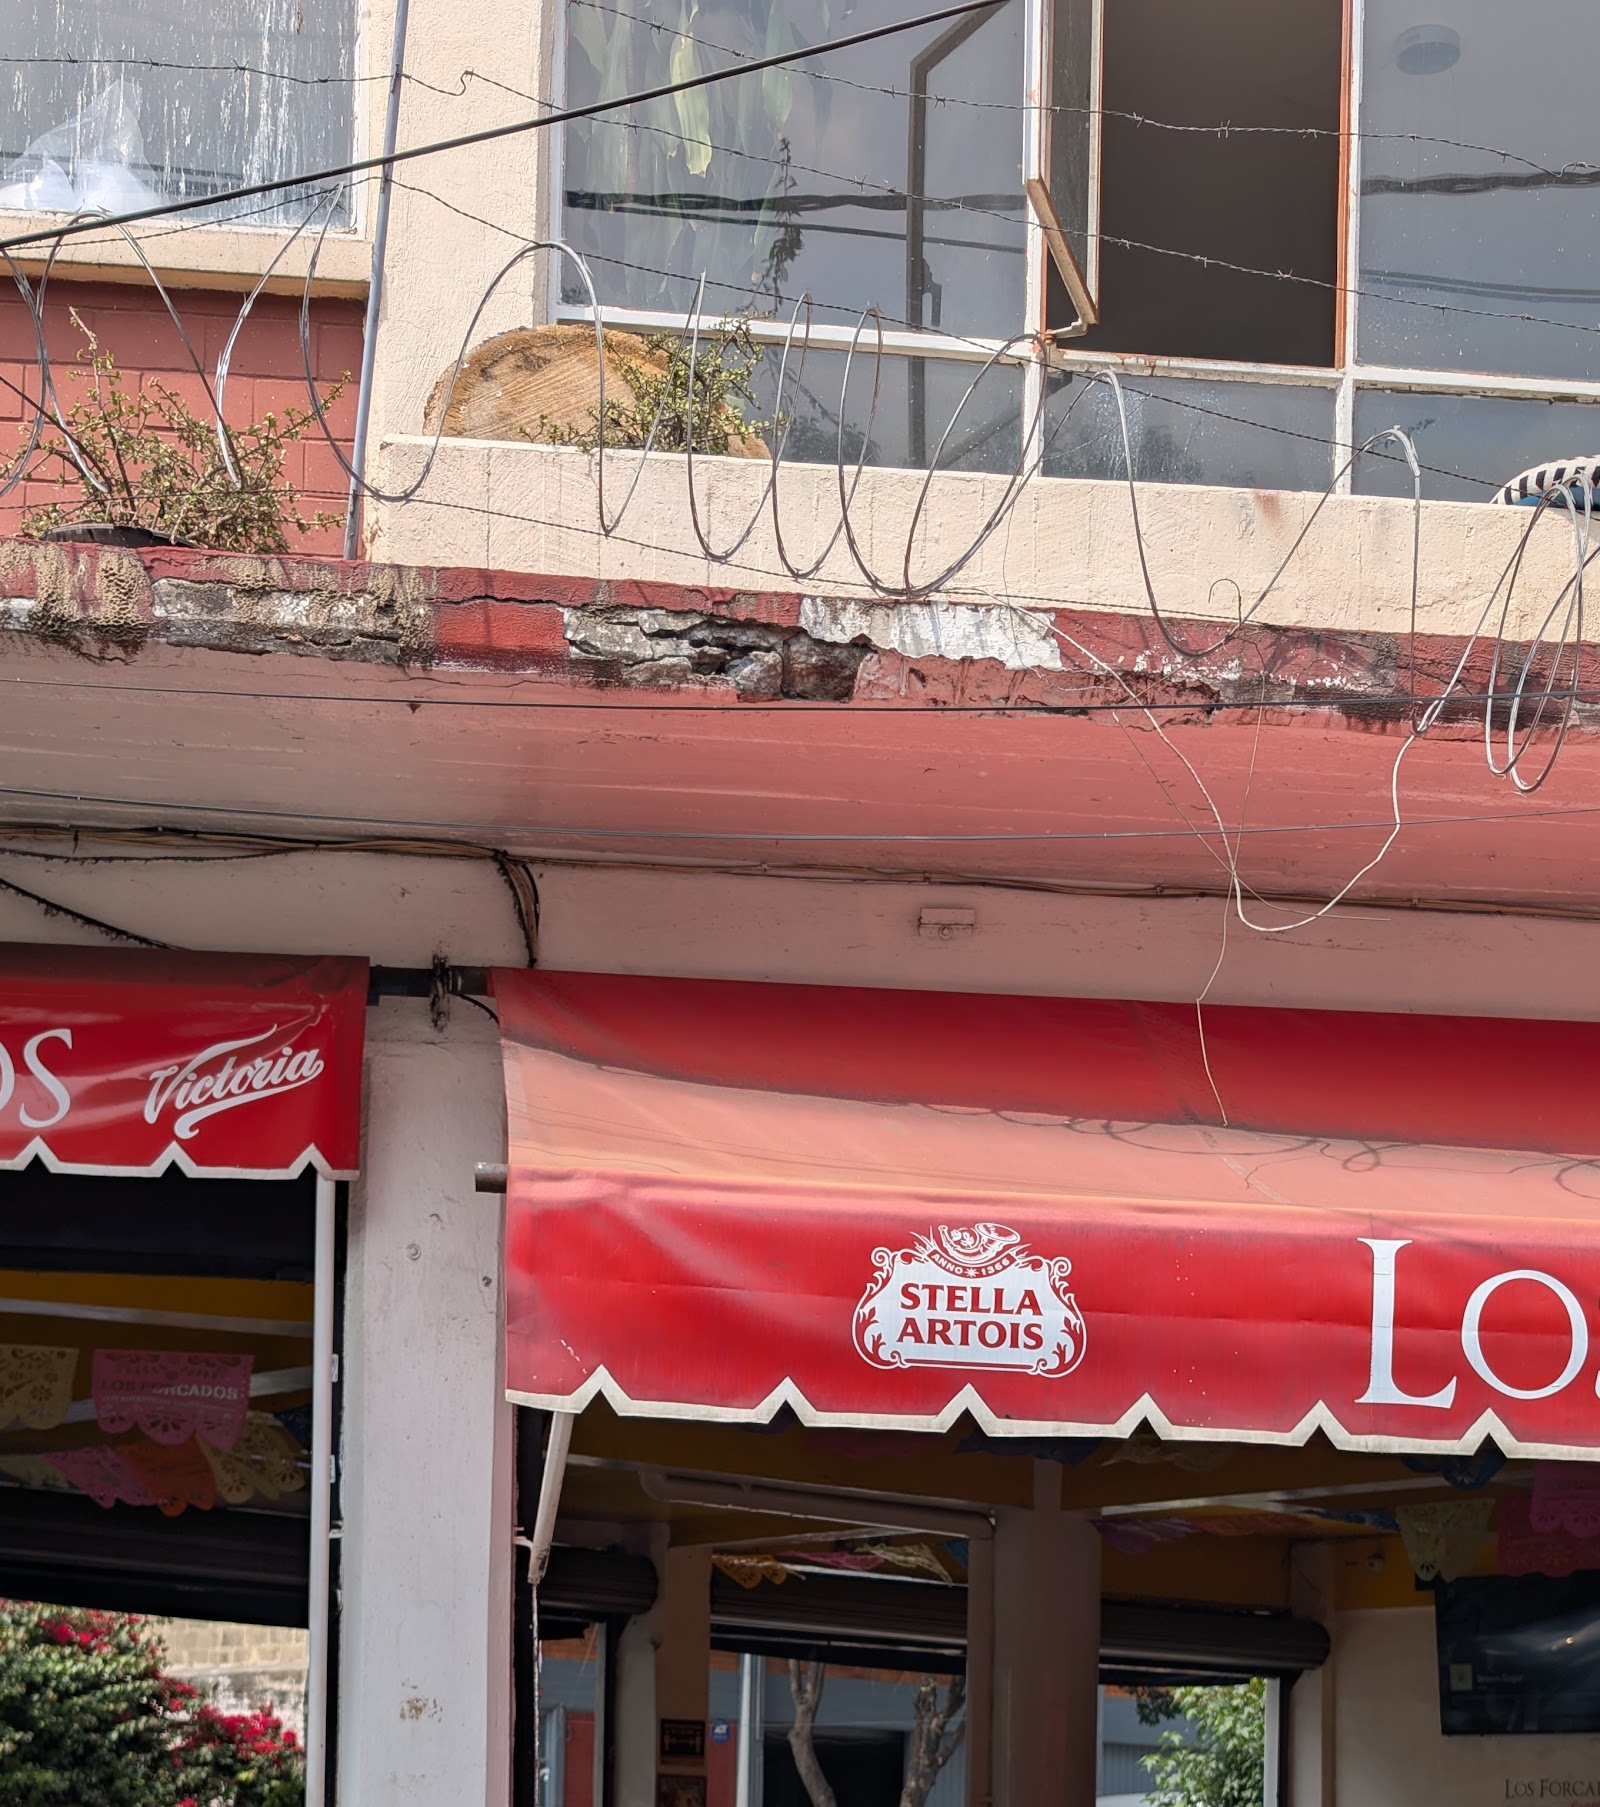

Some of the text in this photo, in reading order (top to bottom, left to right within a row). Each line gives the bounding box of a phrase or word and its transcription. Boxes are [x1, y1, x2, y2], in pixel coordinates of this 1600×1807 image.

[142, 1023, 325, 1140] Victoria
[931, 1253, 1010, 1275] ANNO 1366
[901, 1283, 1043, 1316] STELLA
[896, 1317, 1044, 1350] ARTOIS
[1505, 1779, 1534, 1798] LOS
